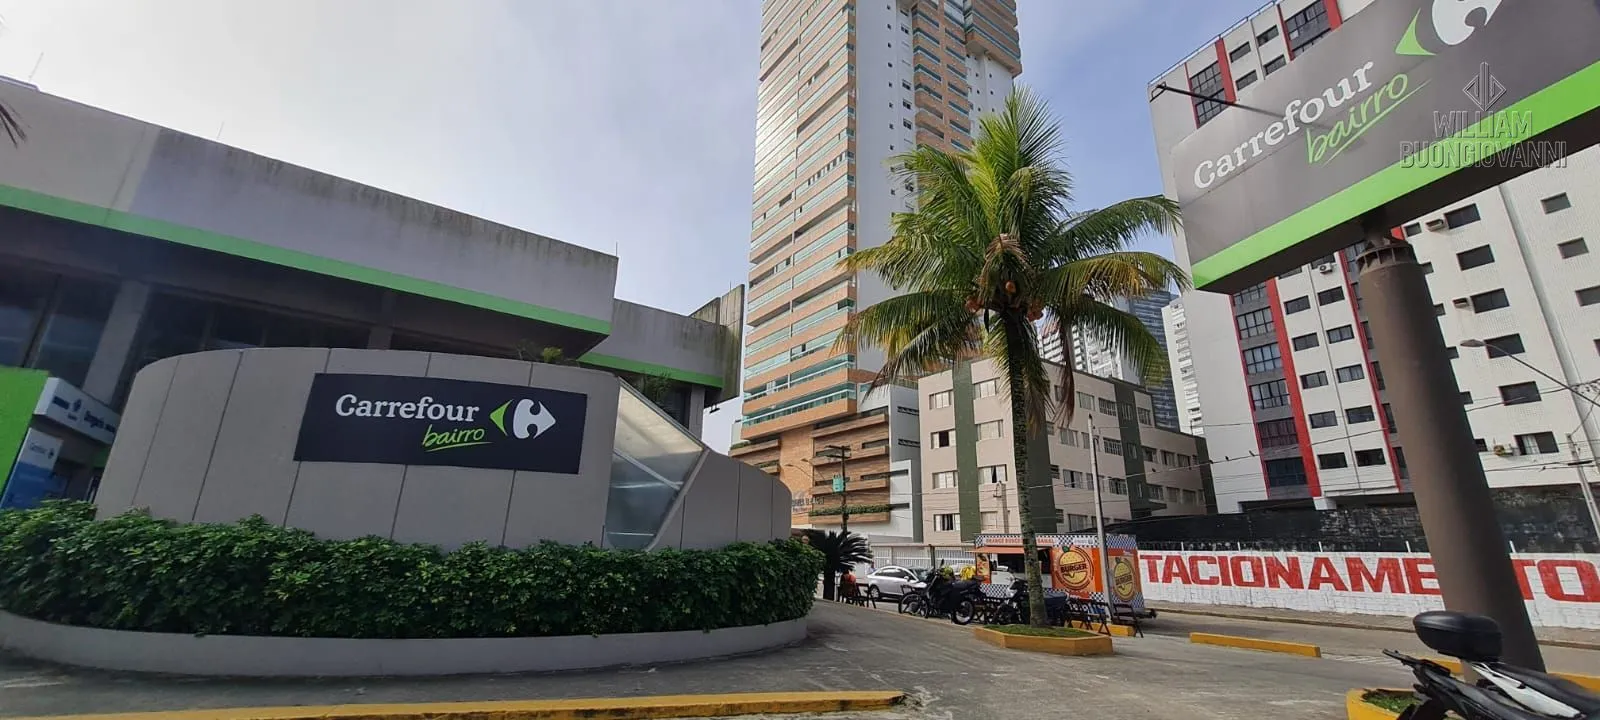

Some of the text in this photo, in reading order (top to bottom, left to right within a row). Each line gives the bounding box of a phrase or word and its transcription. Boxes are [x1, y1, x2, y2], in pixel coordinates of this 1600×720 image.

[1194, 61, 1374, 189] Carrefour
[1305, 73, 1408, 165] bairro
[335, 393, 479, 422] Carrefour
[422, 424, 485, 447] bairro
[1060, 562, 1087, 574] BURGER
